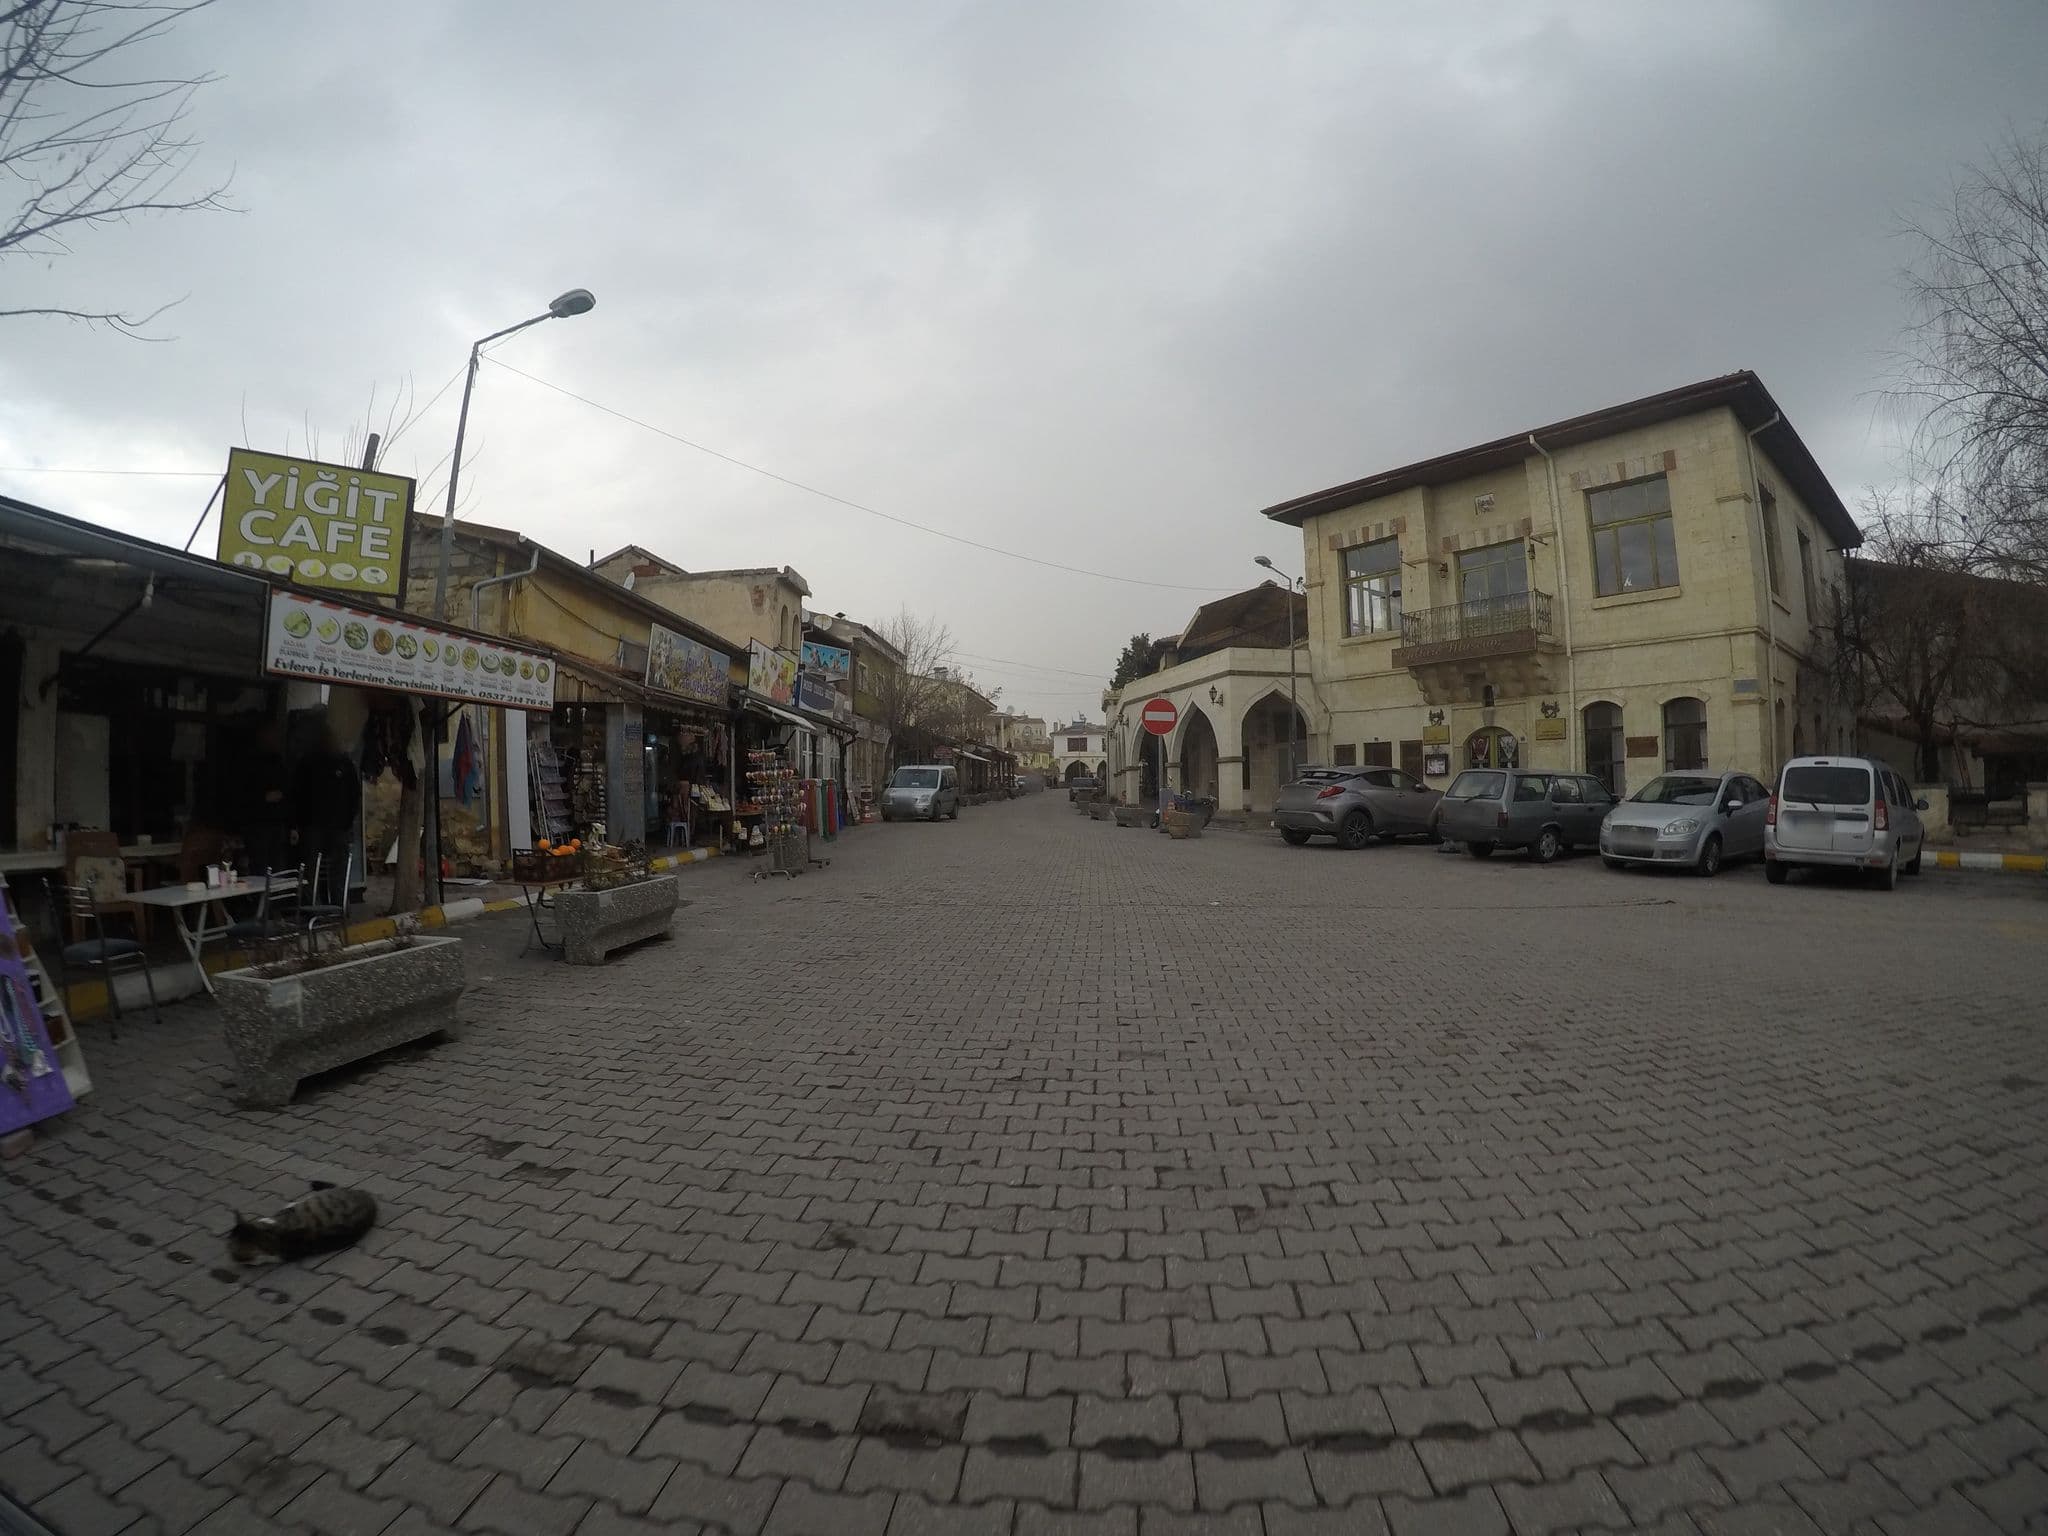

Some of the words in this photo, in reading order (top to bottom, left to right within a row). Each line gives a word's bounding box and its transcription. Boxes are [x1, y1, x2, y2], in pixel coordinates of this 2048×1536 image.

[242, 466, 399, 523] YİĞİT
[239, 509, 391, 560] CAFE
[274, 658, 316, 673] Evlere
[333, 667, 385, 685] Yerlerine
[386, 676, 439, 691] Servisimiz
